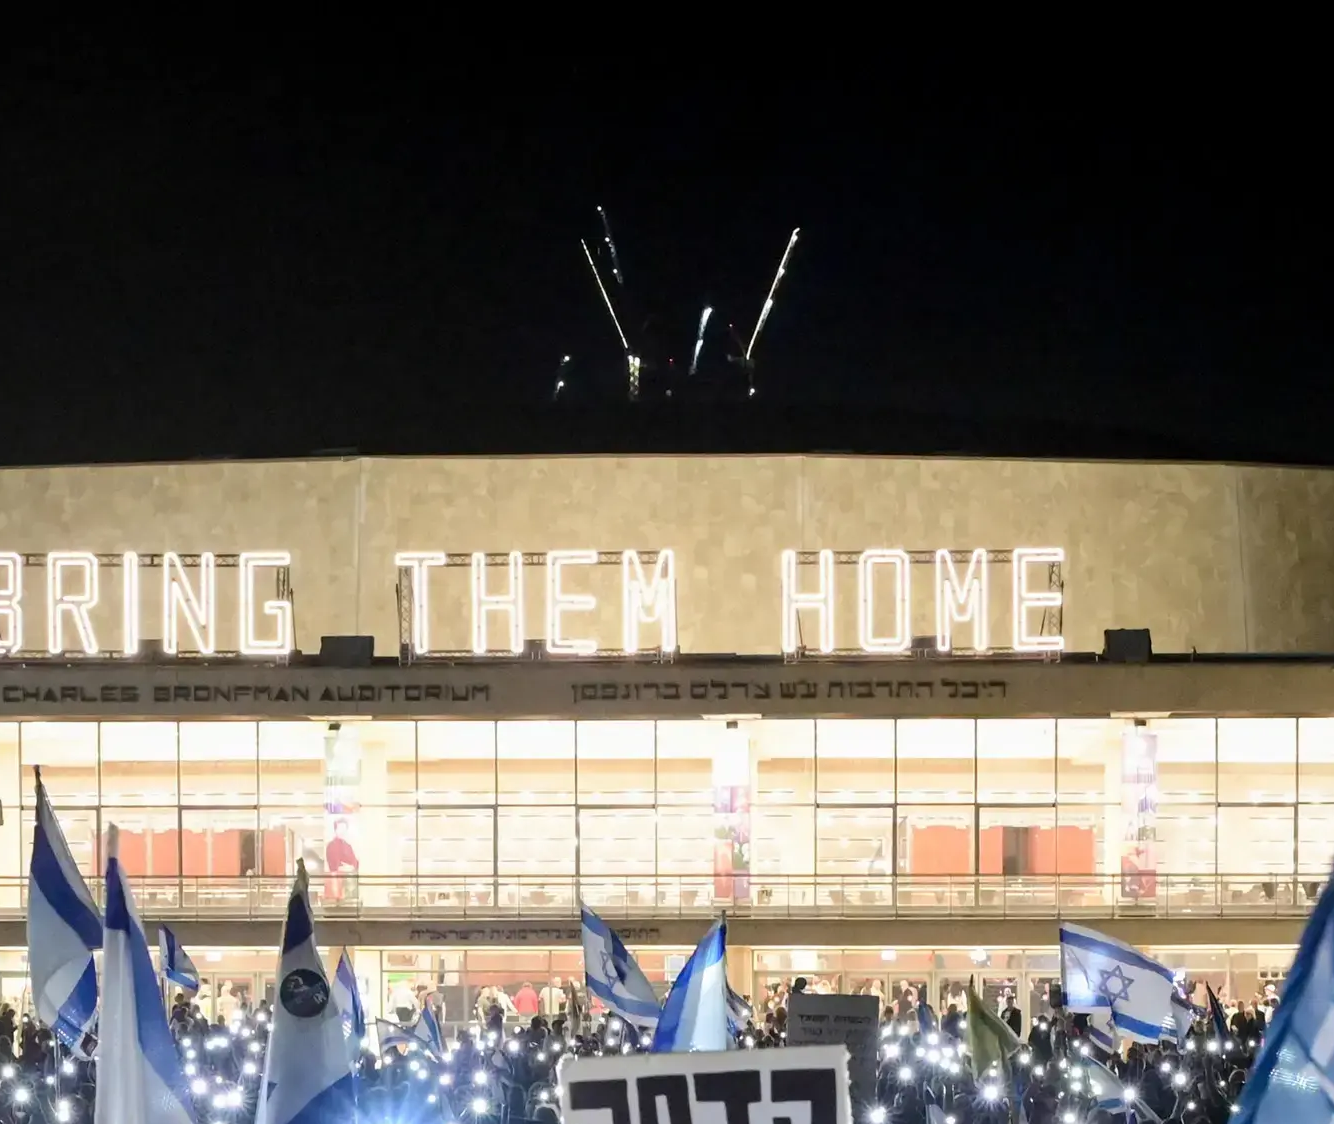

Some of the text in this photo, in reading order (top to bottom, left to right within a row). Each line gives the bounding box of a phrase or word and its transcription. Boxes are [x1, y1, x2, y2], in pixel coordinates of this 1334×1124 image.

[394, 549, 676, 654] THEM
[781, 546, 1064, 652] HOME
[2, 684, 492, 703] CHARLES BRONFMAN AUDITORIUM
[570, 680, 682, 704] ברונפמן
[827, 680, 933, 699] התרבות
[941, 680, 1009, 699] היכל
